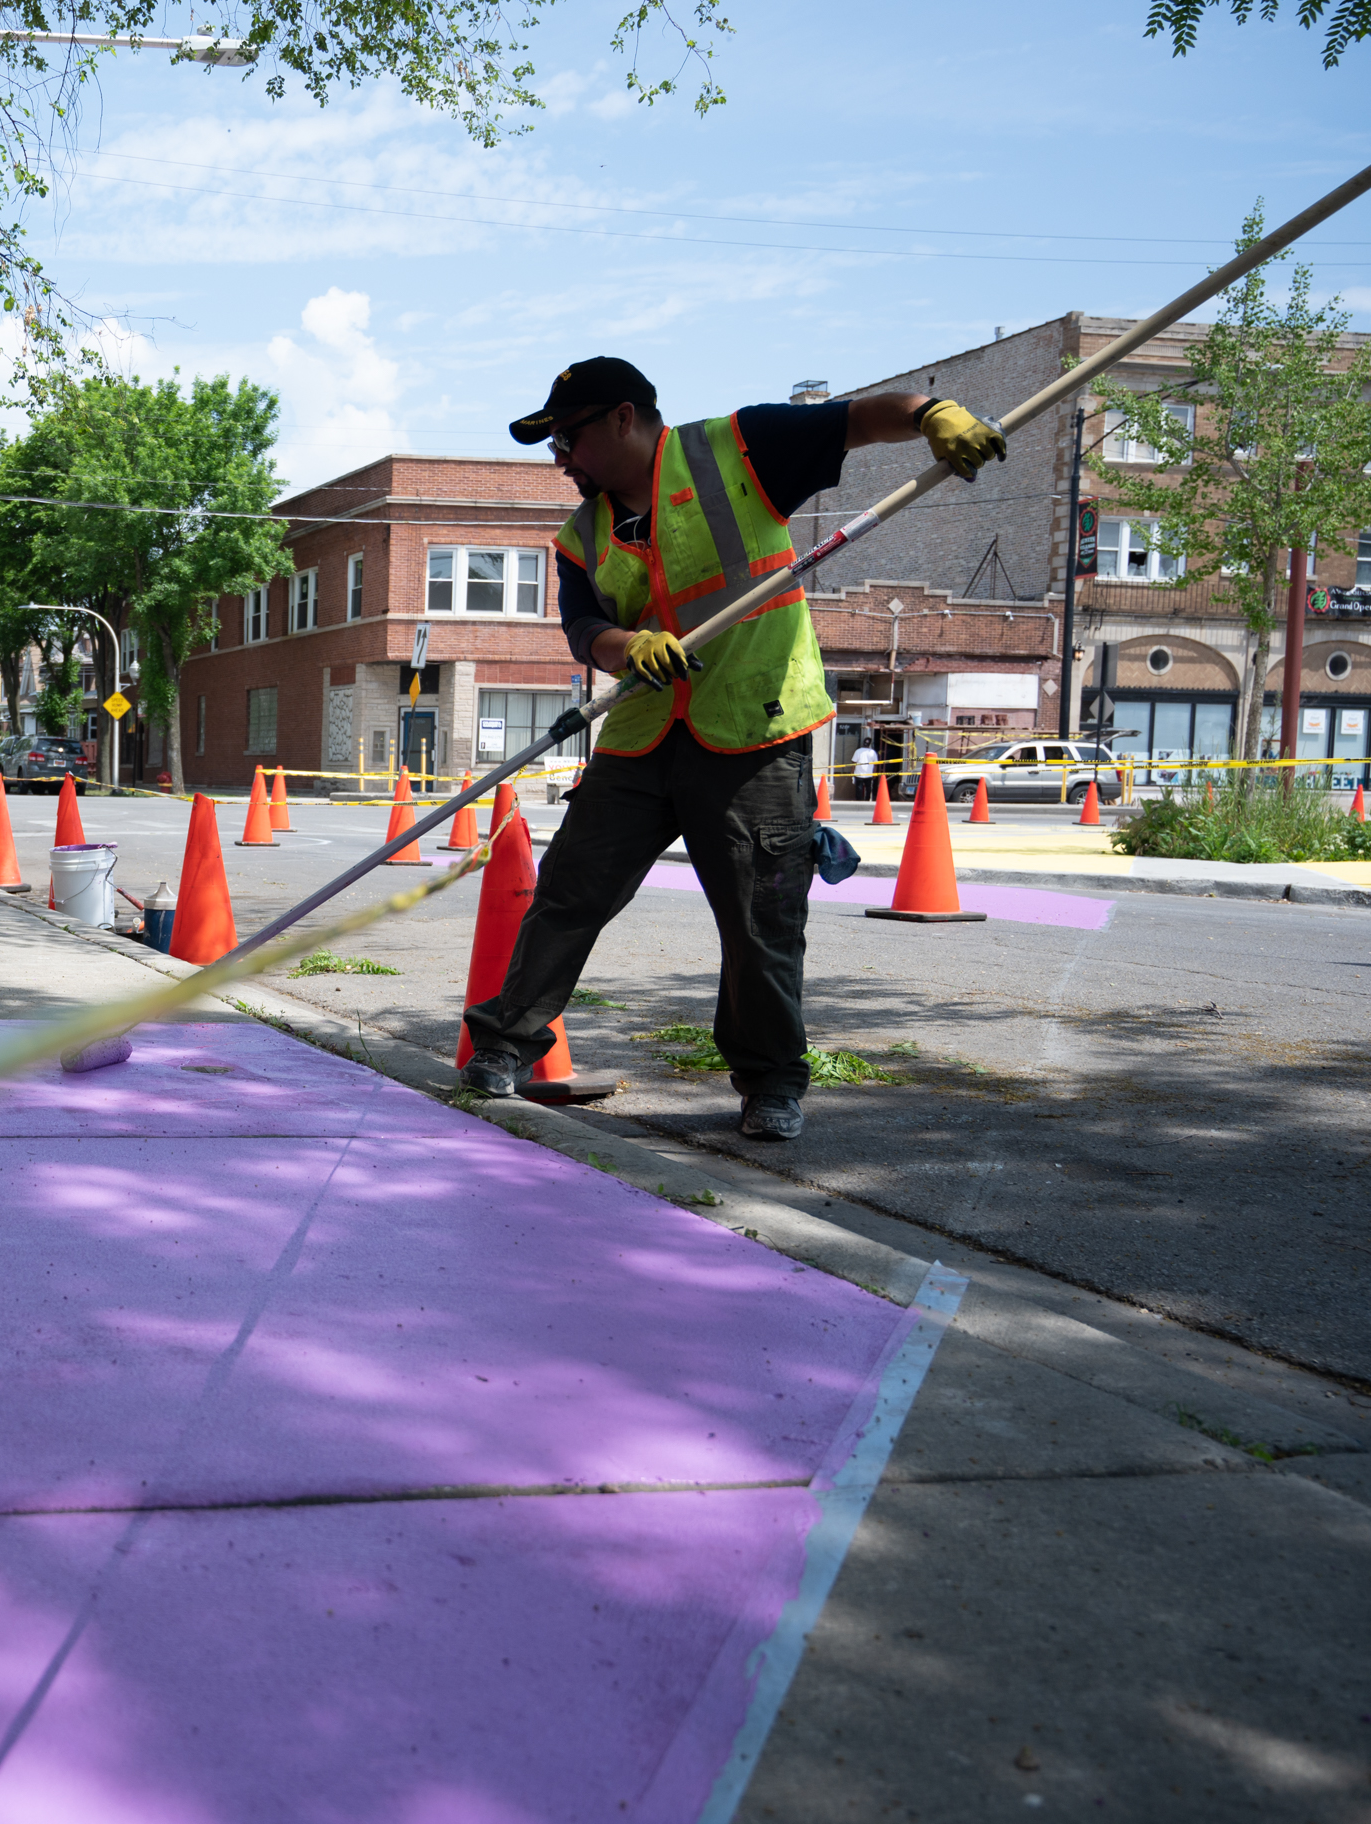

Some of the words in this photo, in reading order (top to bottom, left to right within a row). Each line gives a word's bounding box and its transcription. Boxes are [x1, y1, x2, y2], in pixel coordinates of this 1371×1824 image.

[520, 416, 554, 426] MARINES
[1330, 600, 1353, 610] Grand
[1353, 601, 1371, 612] Ope
